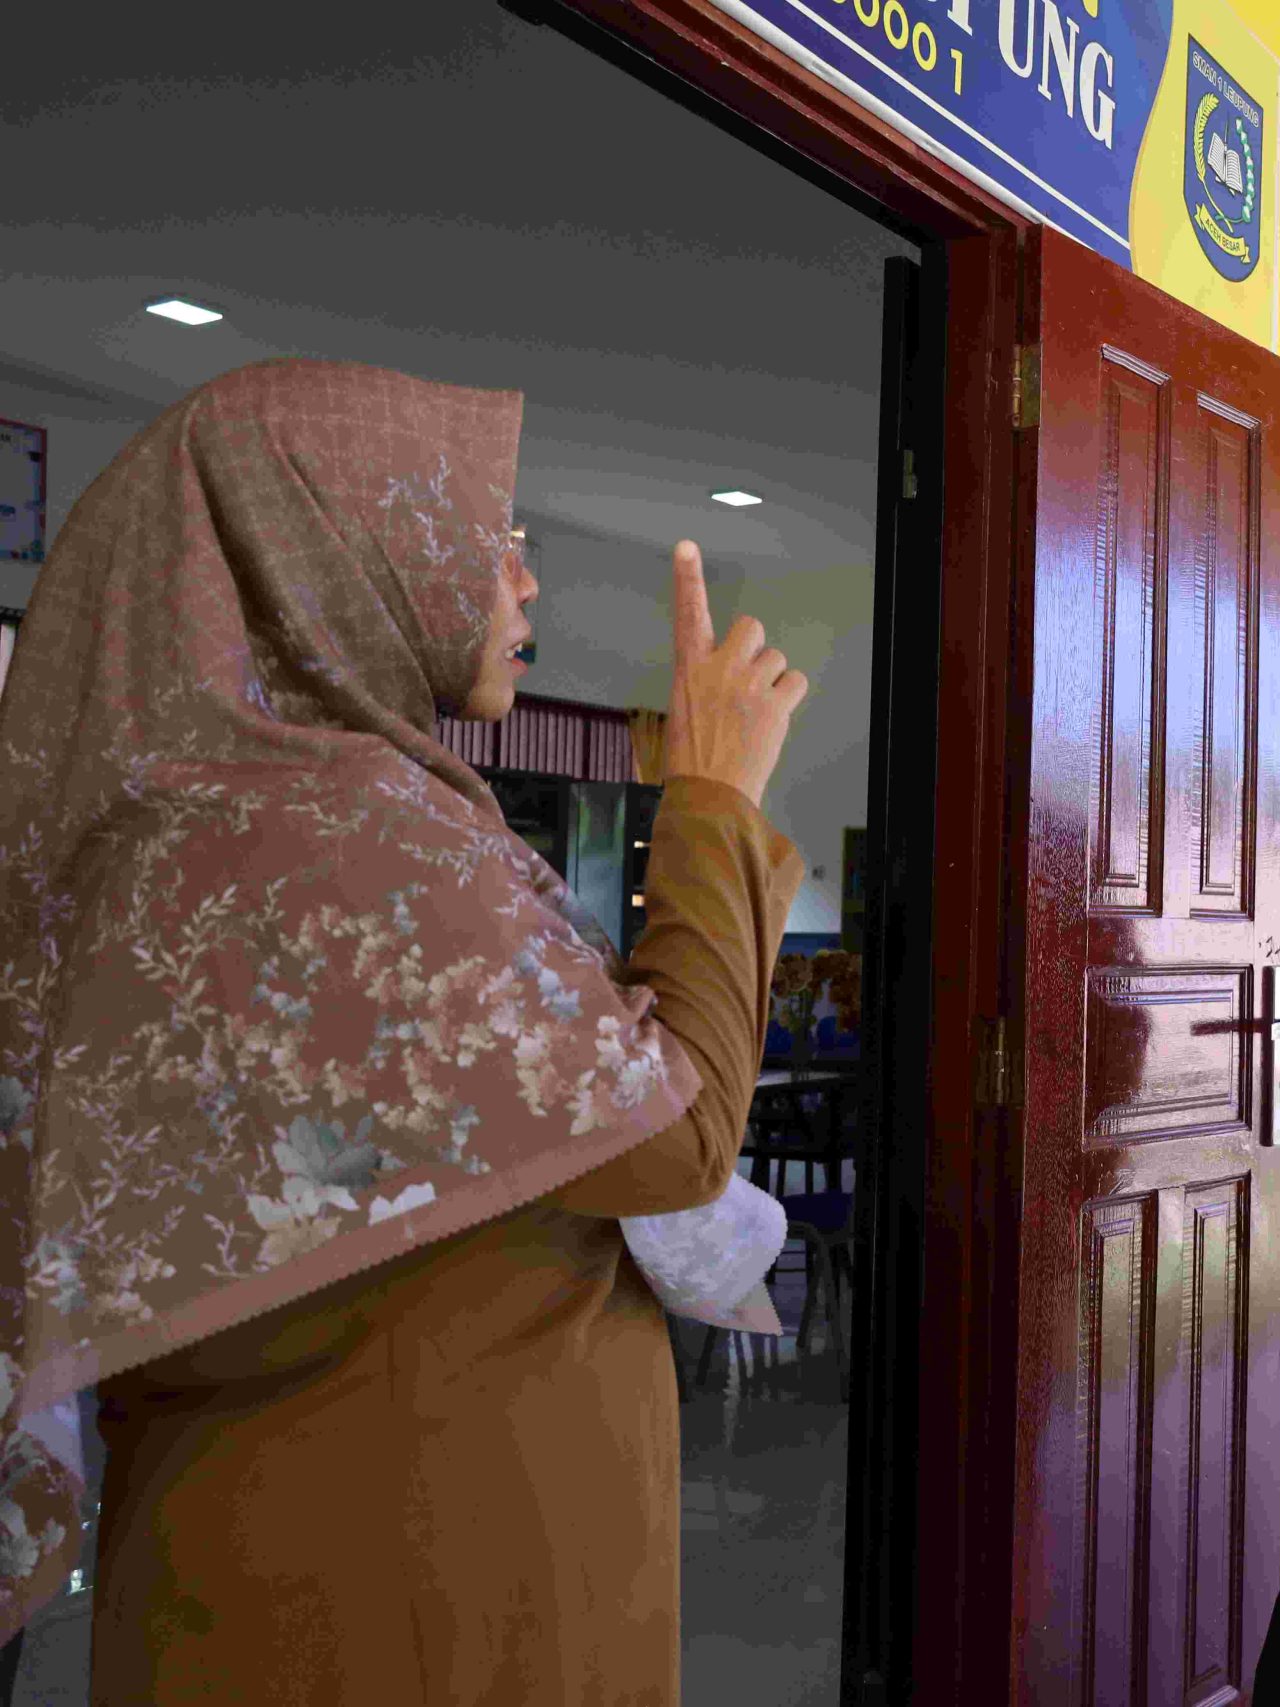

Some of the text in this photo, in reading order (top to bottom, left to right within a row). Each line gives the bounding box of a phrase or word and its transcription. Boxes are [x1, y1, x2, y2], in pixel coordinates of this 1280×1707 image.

[832, 0, 963, 95] 0001
[1193, 51, 1259, 128] SMAN 1 LEUPUNG
[1205, 218, 1240, 251] ACEH BESAR
